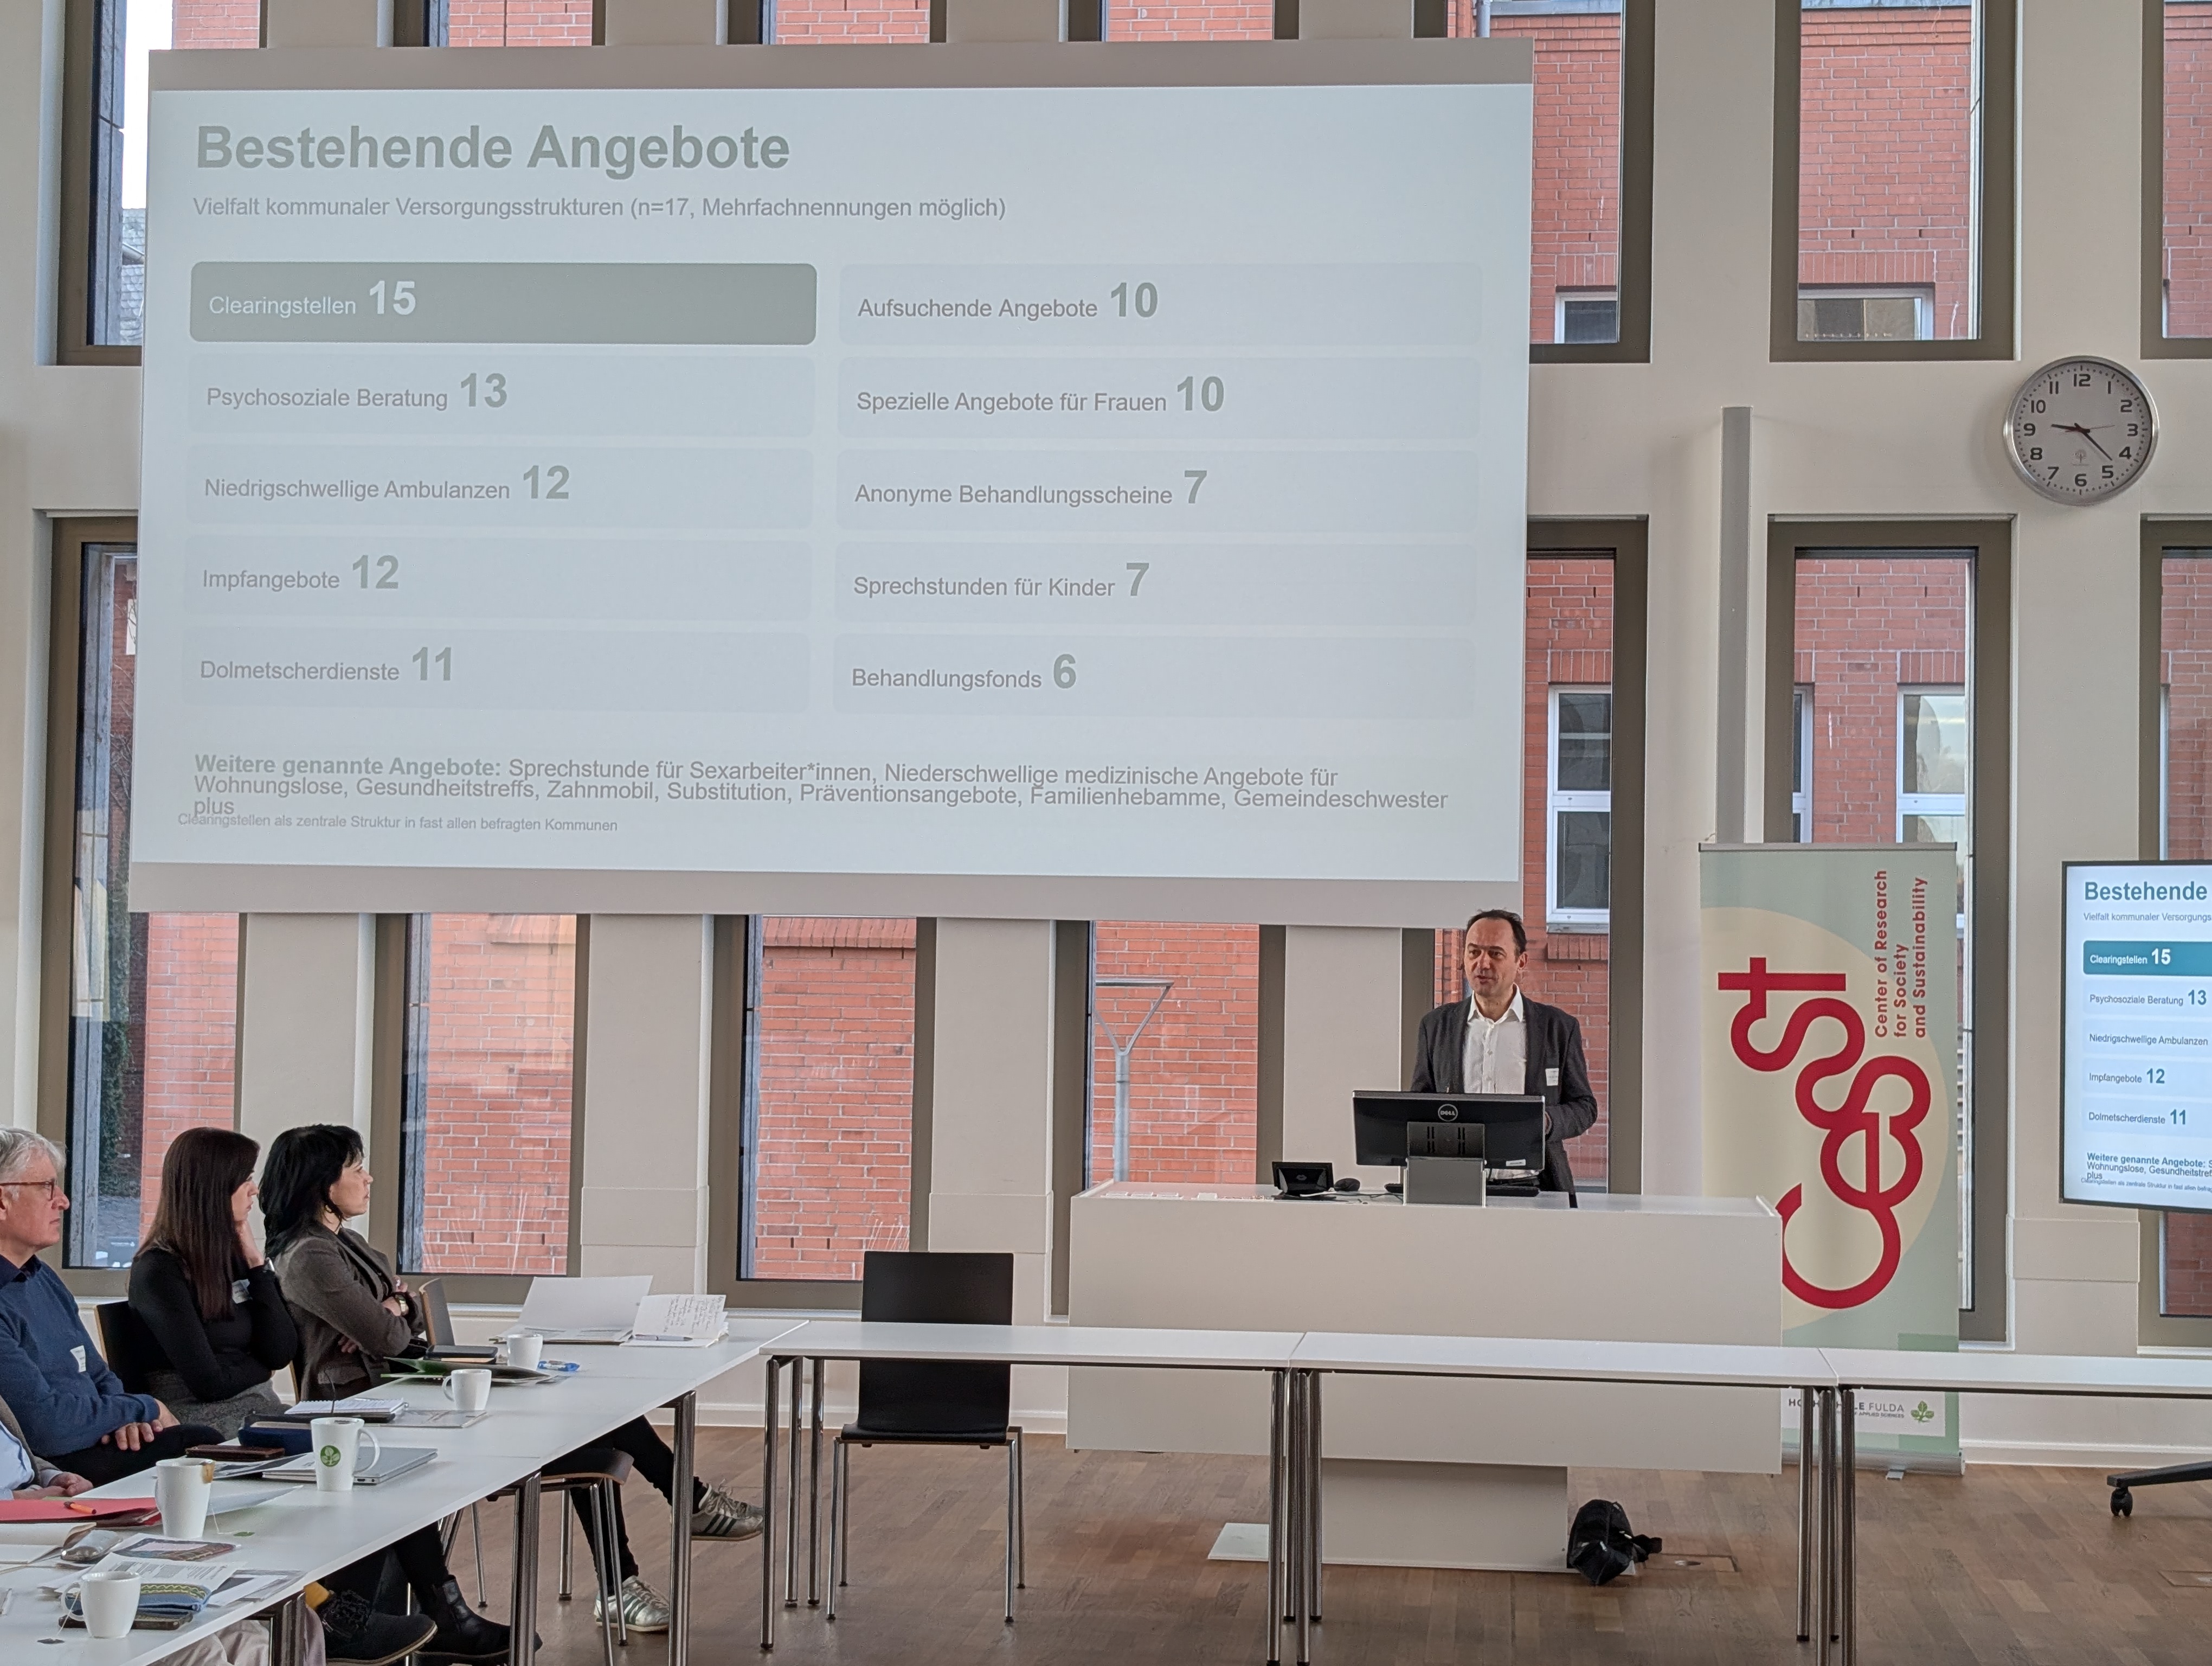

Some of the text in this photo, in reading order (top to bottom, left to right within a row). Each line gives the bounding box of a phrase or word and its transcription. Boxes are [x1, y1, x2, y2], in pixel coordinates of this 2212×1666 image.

[198, 125, 789, 180] Bestehende Angebote
[194, 198, 1005, 220] Vielfalt kommunaler Versorgungsstrukturen (n=17, Mehrfachnennungen möglich)
[210, 281, 415, 318] Clearingstellen 15
[858, 283, 1158, 321] Aufsuchende Angebote 10
[2050, 381, 2059, 394] 11
[2074, 374, 2091, 387] 12
[2108, 381, 2111, 394] 1
[208, 373, 507, 411] Psychosoziale Beratung 13
[858, 376, 1224, 414] Spezielle Angebote für Frauen 10
[2031, 400, 2046, 413] 10
[2120, 400, 2132, 412] 2
[2024, 424, 2035, 436] 9
[2127, 424, 2138, 436] 3
[2030, 447, 2042, 460] 8
[2119, 447, 2131, 459] 4
[2048, 467, 2059, 479] 7
[2075, 474, 2087, 486] 6
[2102, 465, 2113, 478] 5
[205, 465, 569, 501] Niedrigschwellige Ambulanzen 12
[855, 470, 1207, 507] Anonyme Behandlungsscheine 7
[204, 555, 398, 592] Impfangebote 12
[854, 563, 1149, 598] Sprechstunden für Kinder 7
[201, 647, 451, 681] Dolmetscherdienste 11
[853, 654, 1076, 691] Behandlungsfonds 6
[195, 754, 276, 772] Weitere
[282, 757, 384, 778] genannte
[389, 758, 501, 779] Angebote:
[510, 759, 650, 782] Sprechstunde
[656, 760, 684, 780] für
[885, 764, 1058, 788] Niederschwellige
[1065, 765, 1197, 786] medizinische
[1204, 766, 1303, 790] Angebote
[1310, 768, 1338, 787] für
[194, 776, 1448, 811] Wohnungslose, Gesundheitstreffs, Zahnmobil, Substitution, Präventionsangebote, Familienhebamme, Gemeindeschwester
[194, 797, 234, 817] plus
[274, 815, 292, 826] als
[297, 816, 346, 826] zentrale
[351, 816, 400, 828] Struktur
[406, 817, 415, 828] in
[420, 817, 442, 828] fast
[447, 817, 476, 829] allen
[481, 818, 540, 832] befragten
[545, 819, 617, 831] Kommunen
[2085, 881, 2208, 900] Bestehende
[2083, 912, 2110, 921] Vielfalt
[2111, 913, 2159, 921] kommunaler
[1874, 870, 1888, 1037] Center of Research
[1912, 877, 1928, 1038] and Sustainability
[2090, 948, 2171, 966] Clearingstellen 15
[1893, 944, 1909, 1038] for Society
[2089, 989, 2207, 1007] Psychosoziale Beratung 13
[2089, 1033, 2208, 1046] Niedrigschwellige Ambulanzen
[2089, 1068, 2165, 1084] Impfangebote 12
[2088, 1109, 2186, 1125] Dolmetscherdienste 11
[2087, 1152, 2118, 1162] Weitere
[2121, 1156, 2159, 1165] genannte
[2162, 1157, 2205, 1168] Angebote:
[2087, 1162, 2146, 1174] Wohnungslose,
[1869, 1402, 1904, 1412] FULDA
